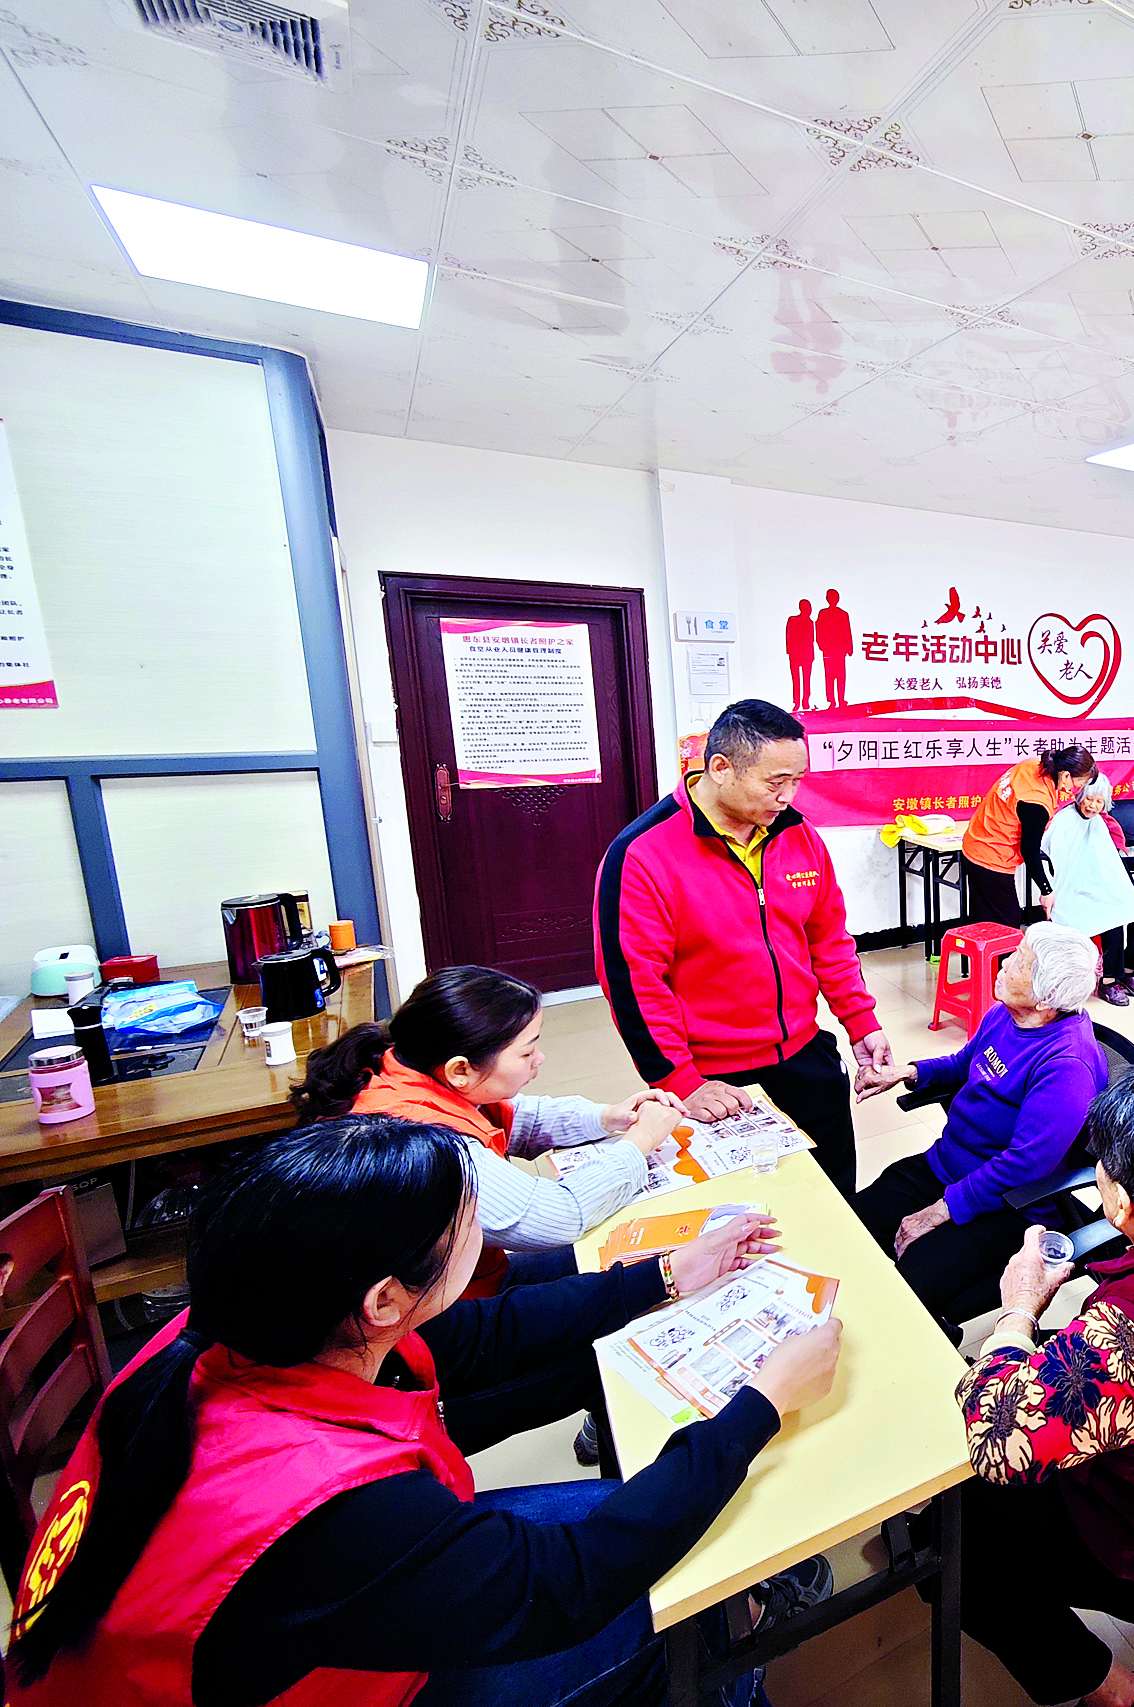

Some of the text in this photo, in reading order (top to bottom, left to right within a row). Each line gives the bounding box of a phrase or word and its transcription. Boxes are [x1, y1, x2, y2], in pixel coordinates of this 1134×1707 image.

[704, 619, 729, 630] 食堂
[861, 631, 1023, 666] 老年活动中心
[1037, 629, 1068, 655] 关爱
[1058, 659, 1093, 681] 老人
[893, 676, 1003, 691] 关爱老人 弘扬美德
[892, 794, 985, 812] 安墩镇长者照护
